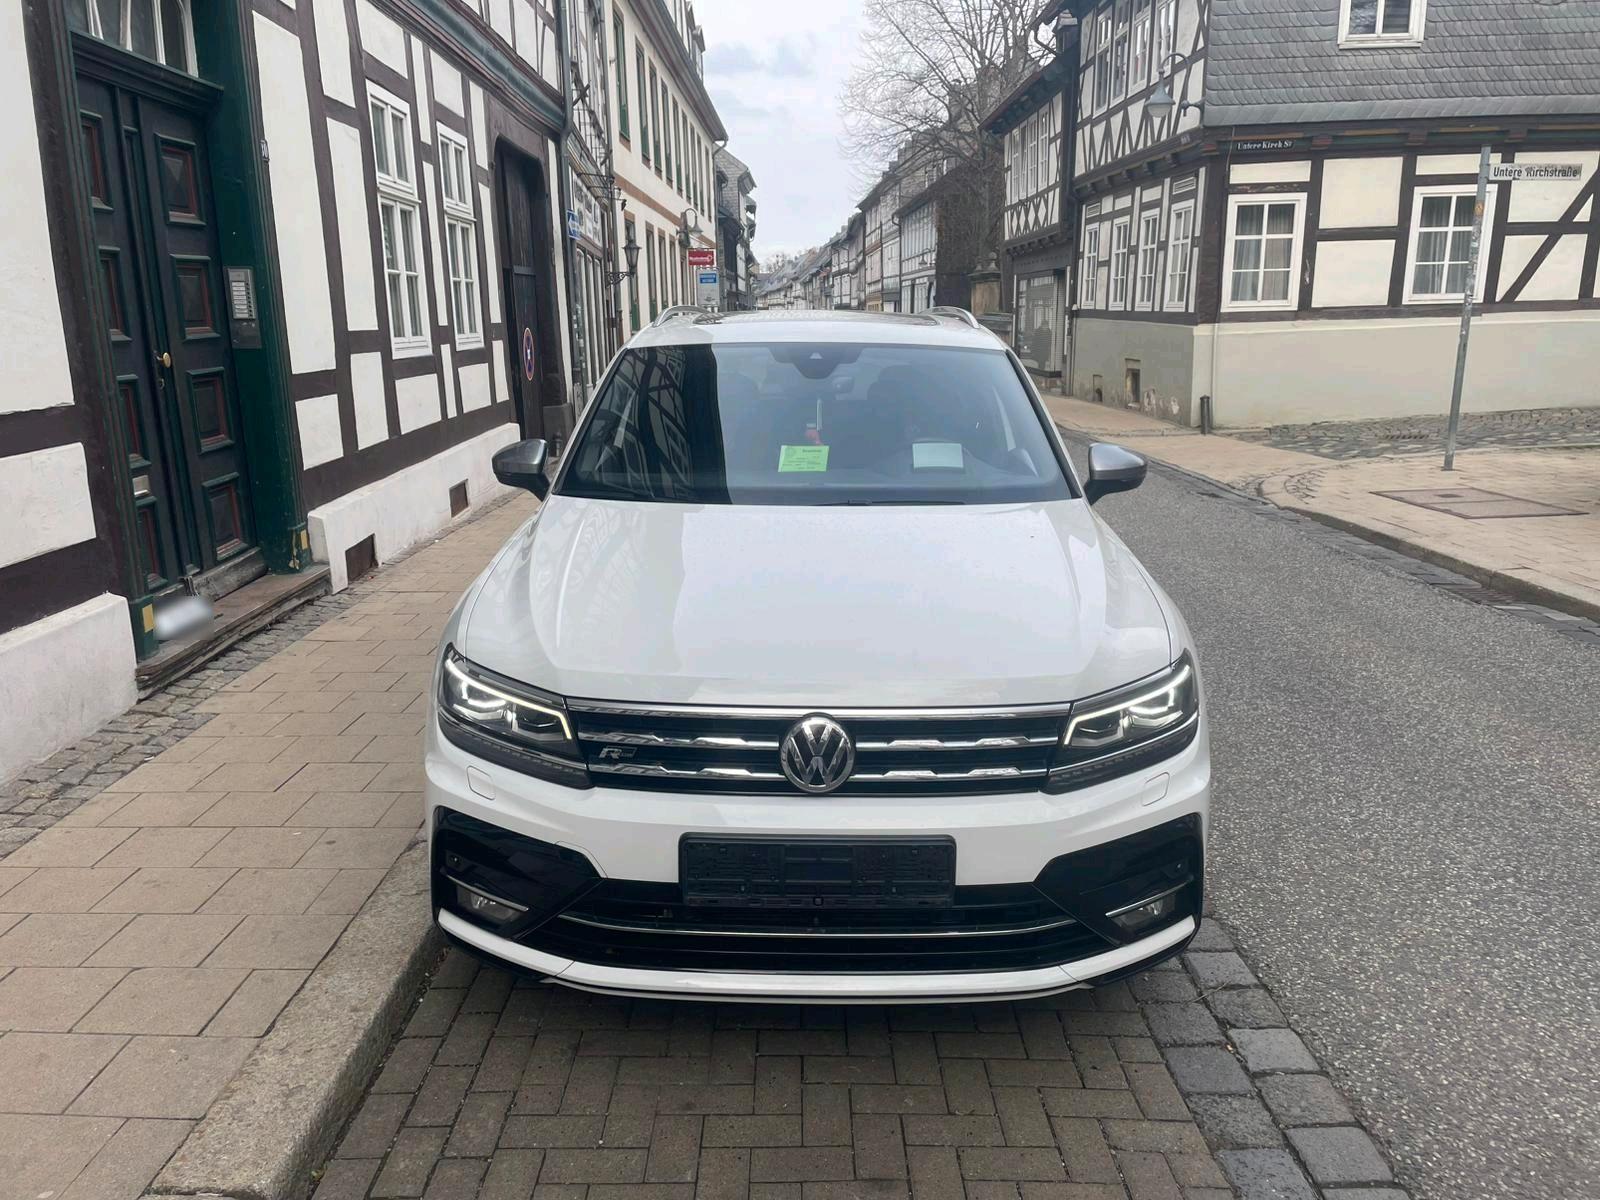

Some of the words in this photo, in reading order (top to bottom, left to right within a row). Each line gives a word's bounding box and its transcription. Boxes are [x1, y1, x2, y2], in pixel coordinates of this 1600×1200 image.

[1493, 166, 1522, 177] Untere
[1525, 166, 1578, 177] Kirchstraße
[781, 716, 854, 792] VW
